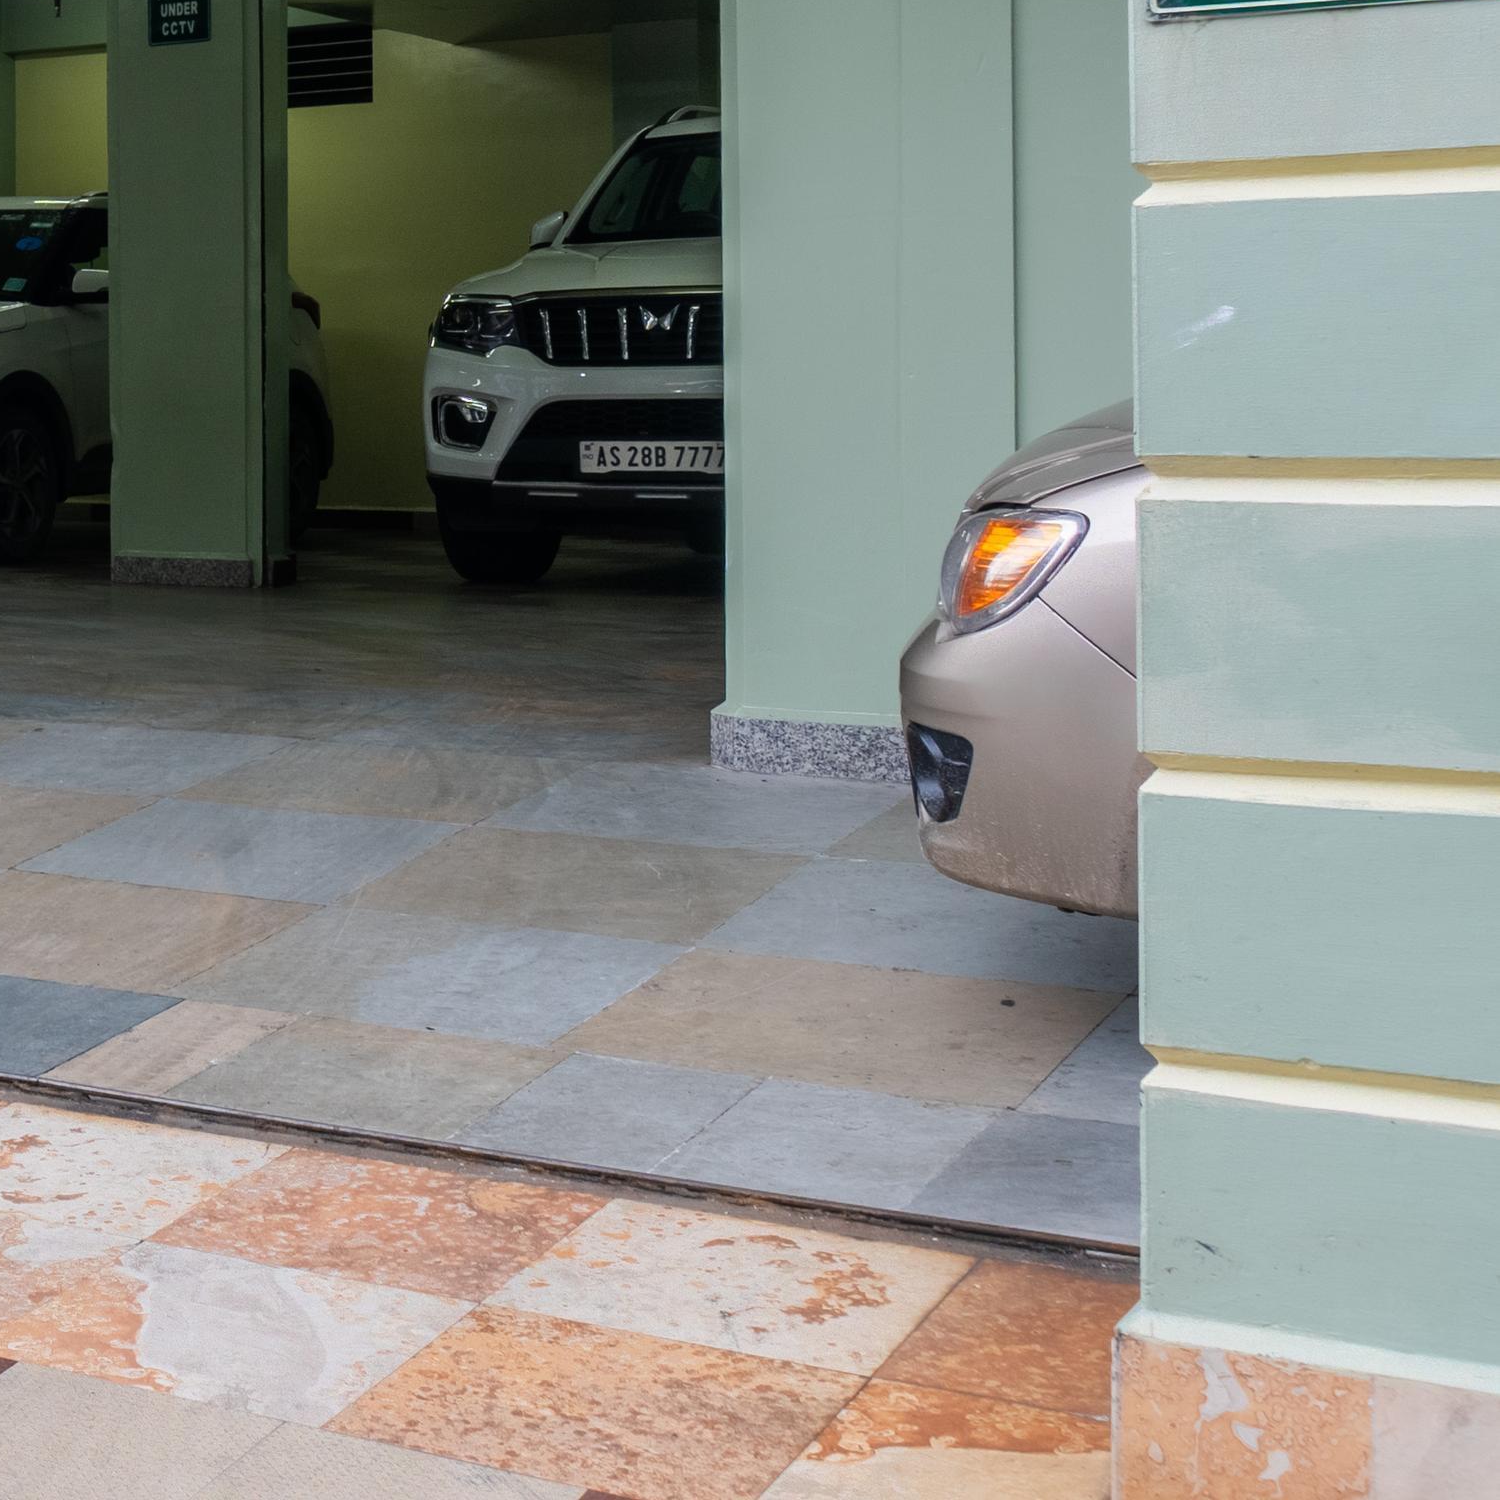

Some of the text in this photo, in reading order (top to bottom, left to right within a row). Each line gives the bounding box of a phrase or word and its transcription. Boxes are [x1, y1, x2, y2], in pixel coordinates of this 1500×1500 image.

[160, 1, 198, 17] UNDER
[161, 20, 195, 36] CCTV
[597, 446, 621, 467] AS
[627, 446, 666, 467] 28B
